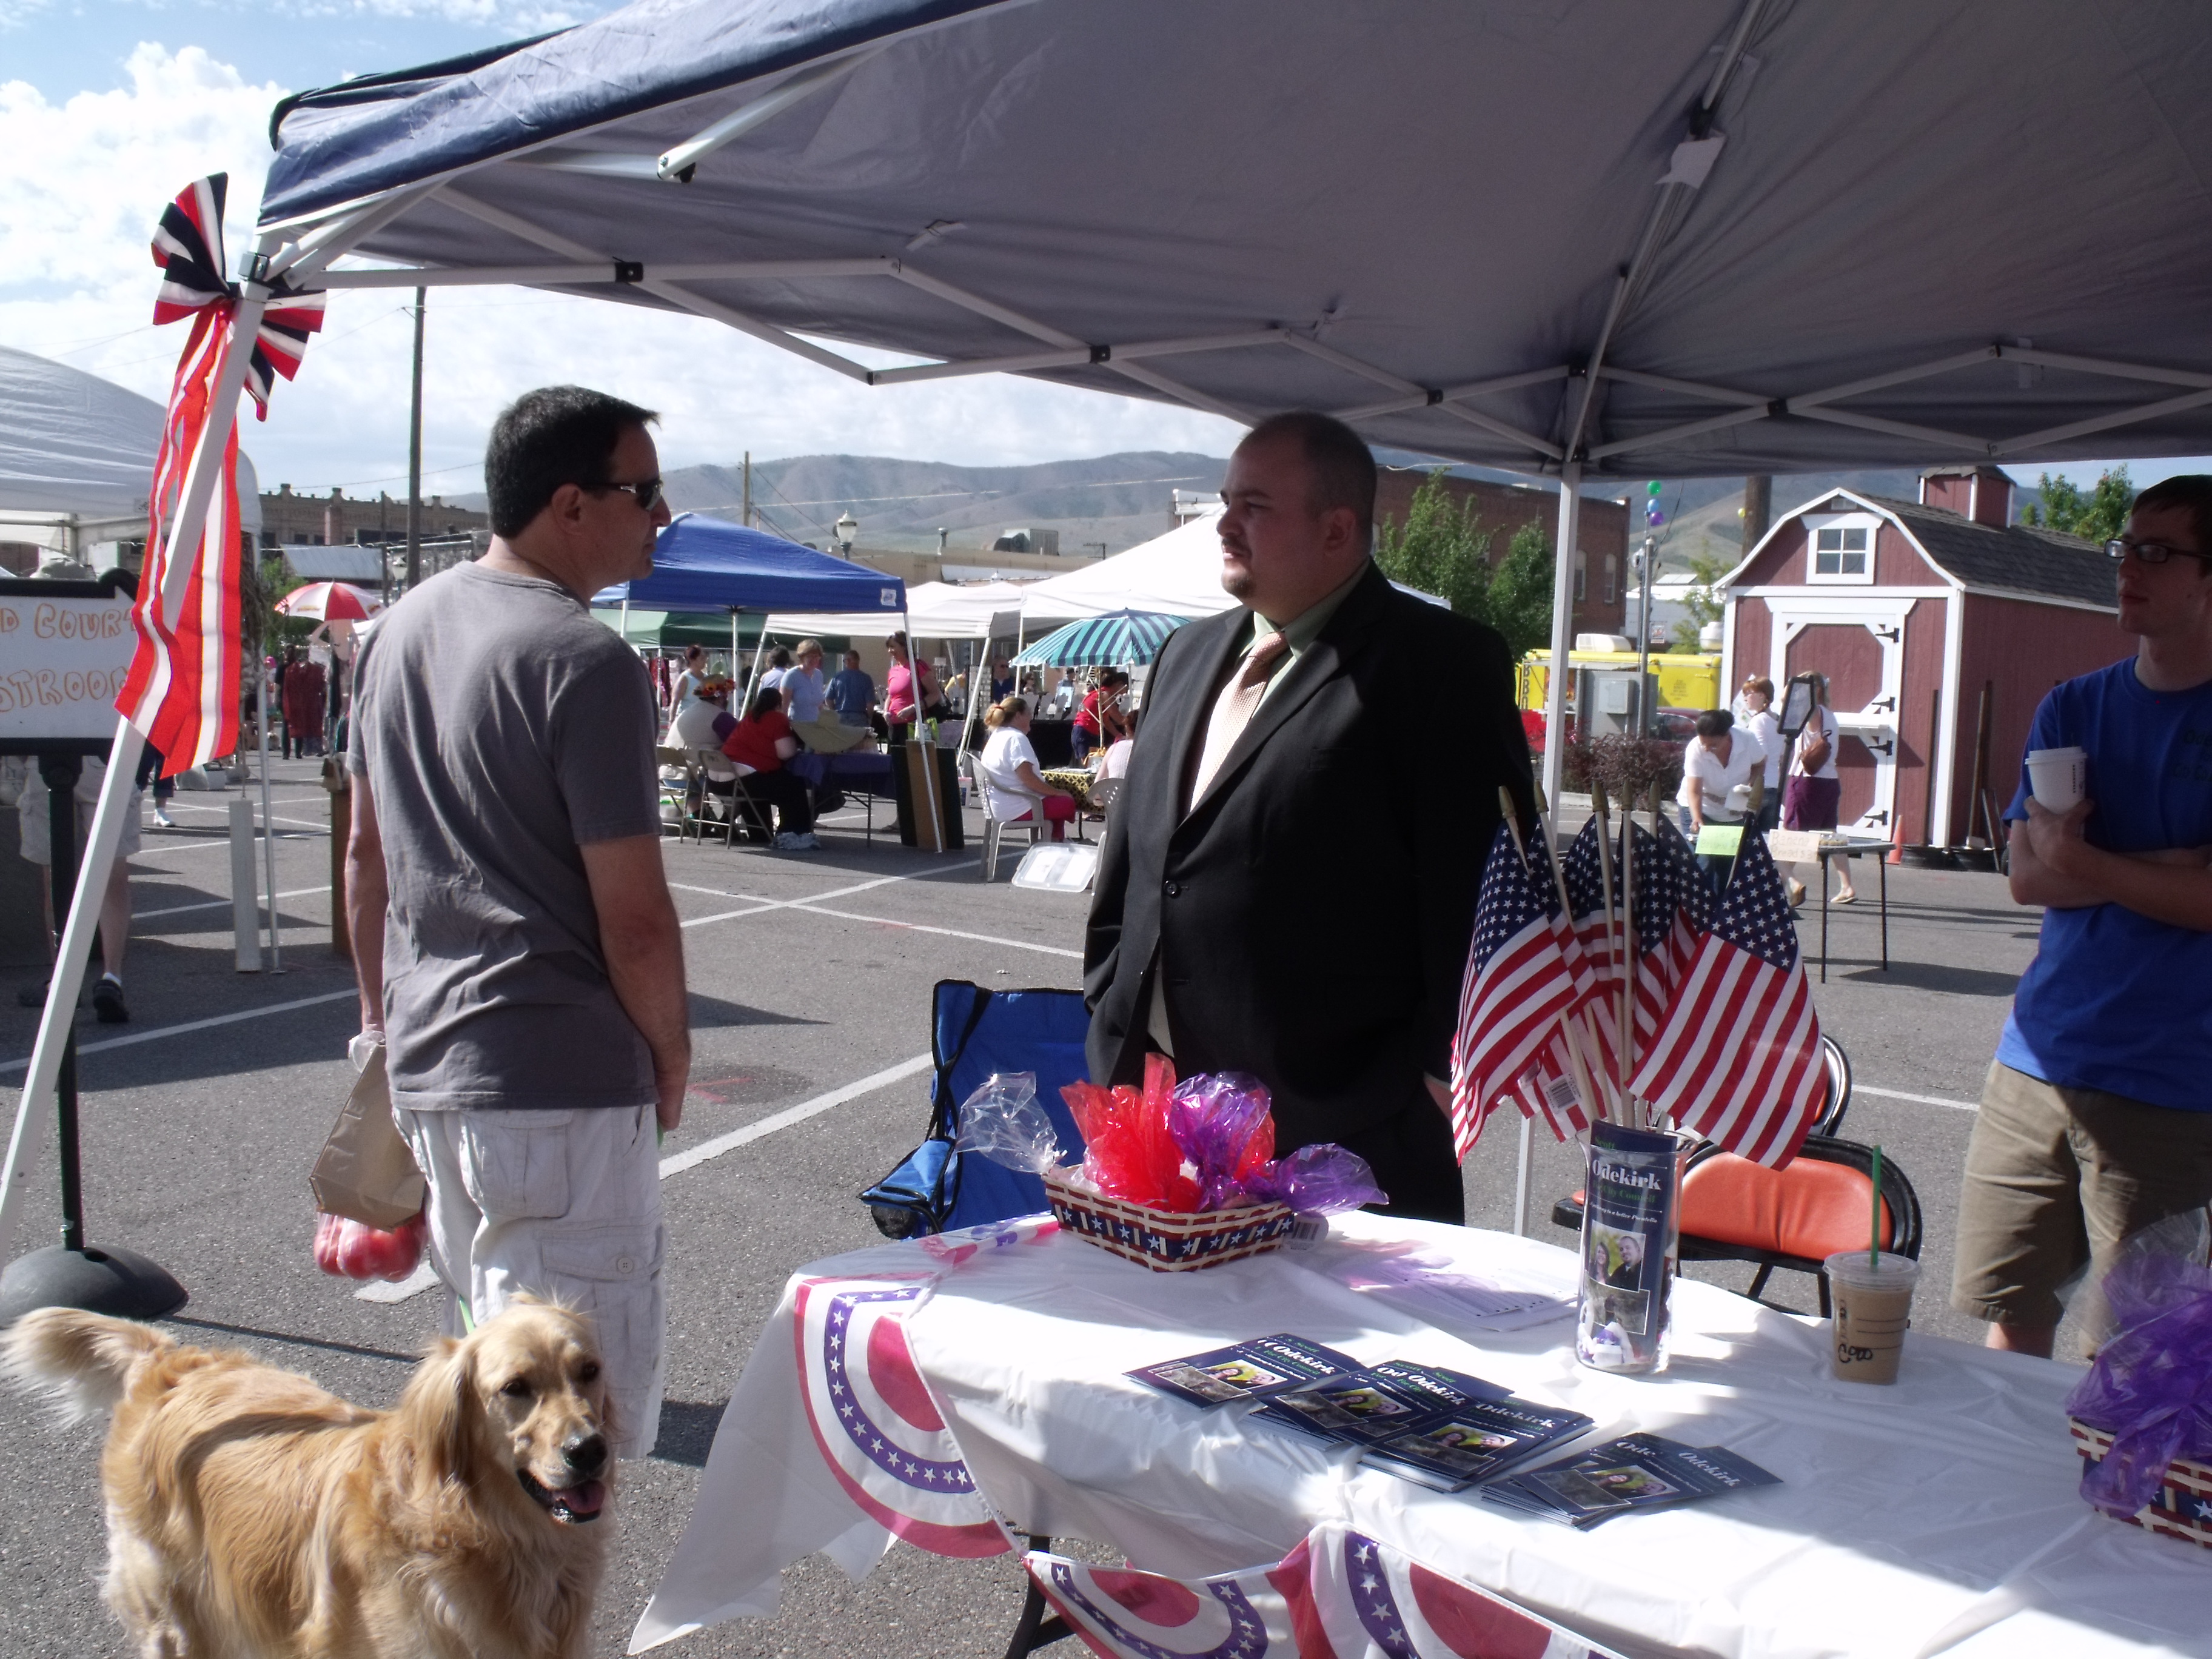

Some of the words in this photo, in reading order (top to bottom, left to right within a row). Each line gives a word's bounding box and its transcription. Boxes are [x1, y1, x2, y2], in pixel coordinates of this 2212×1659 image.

[1772, 831, 1810, 846] Banana
[1592, 1159, 1661, 1190] Odekirk
[1273, 1346, 1335, 1375] Odekirk
[1408, 1375, 1466, 1406] Odekirk
[1475, 1403, 1555, 1428] Odekirk
[1678, 1452, 1740, 1487] Odekirk
